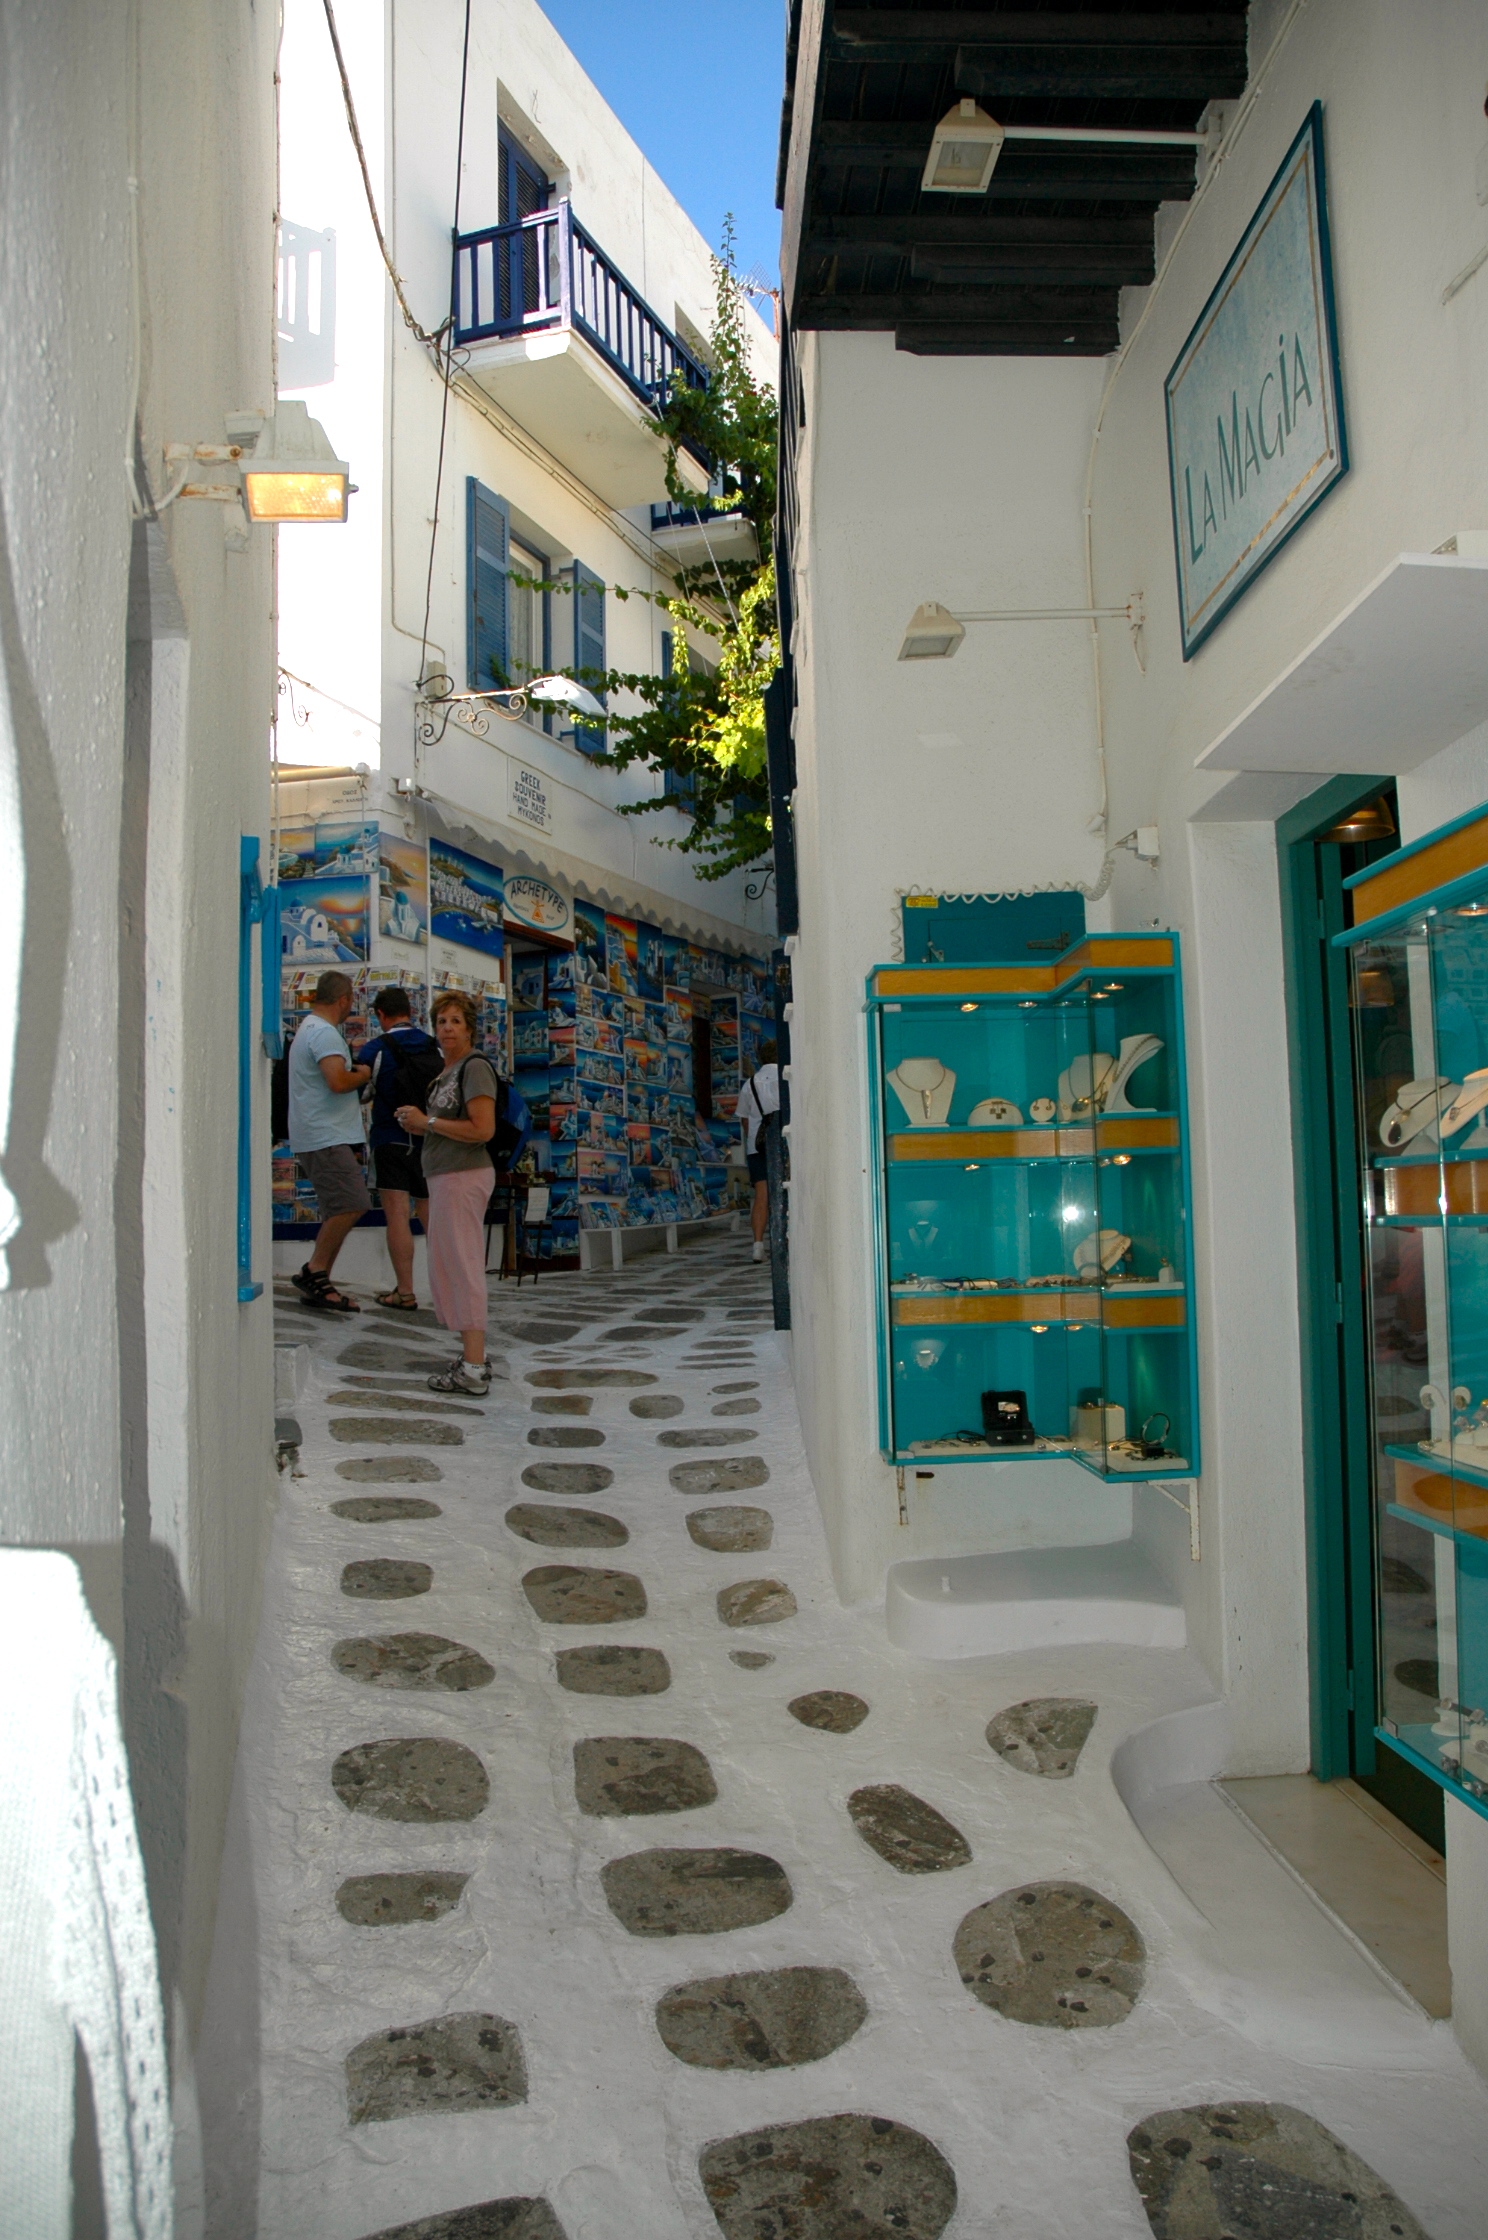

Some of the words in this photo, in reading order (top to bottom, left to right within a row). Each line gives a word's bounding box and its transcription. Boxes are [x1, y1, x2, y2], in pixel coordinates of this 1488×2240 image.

[1184, 464, 1218, 566] LA
[514, 780, 547, 806] SOUVENIR
[520, 770, 541, 791] GREEK
[512, 792, 529, 808] HAND
[531, 802, 547, 817] MADE
[517, 805, 545, 827] MYKONOS
[510, 880, 565, 914] ARCHETYPE
